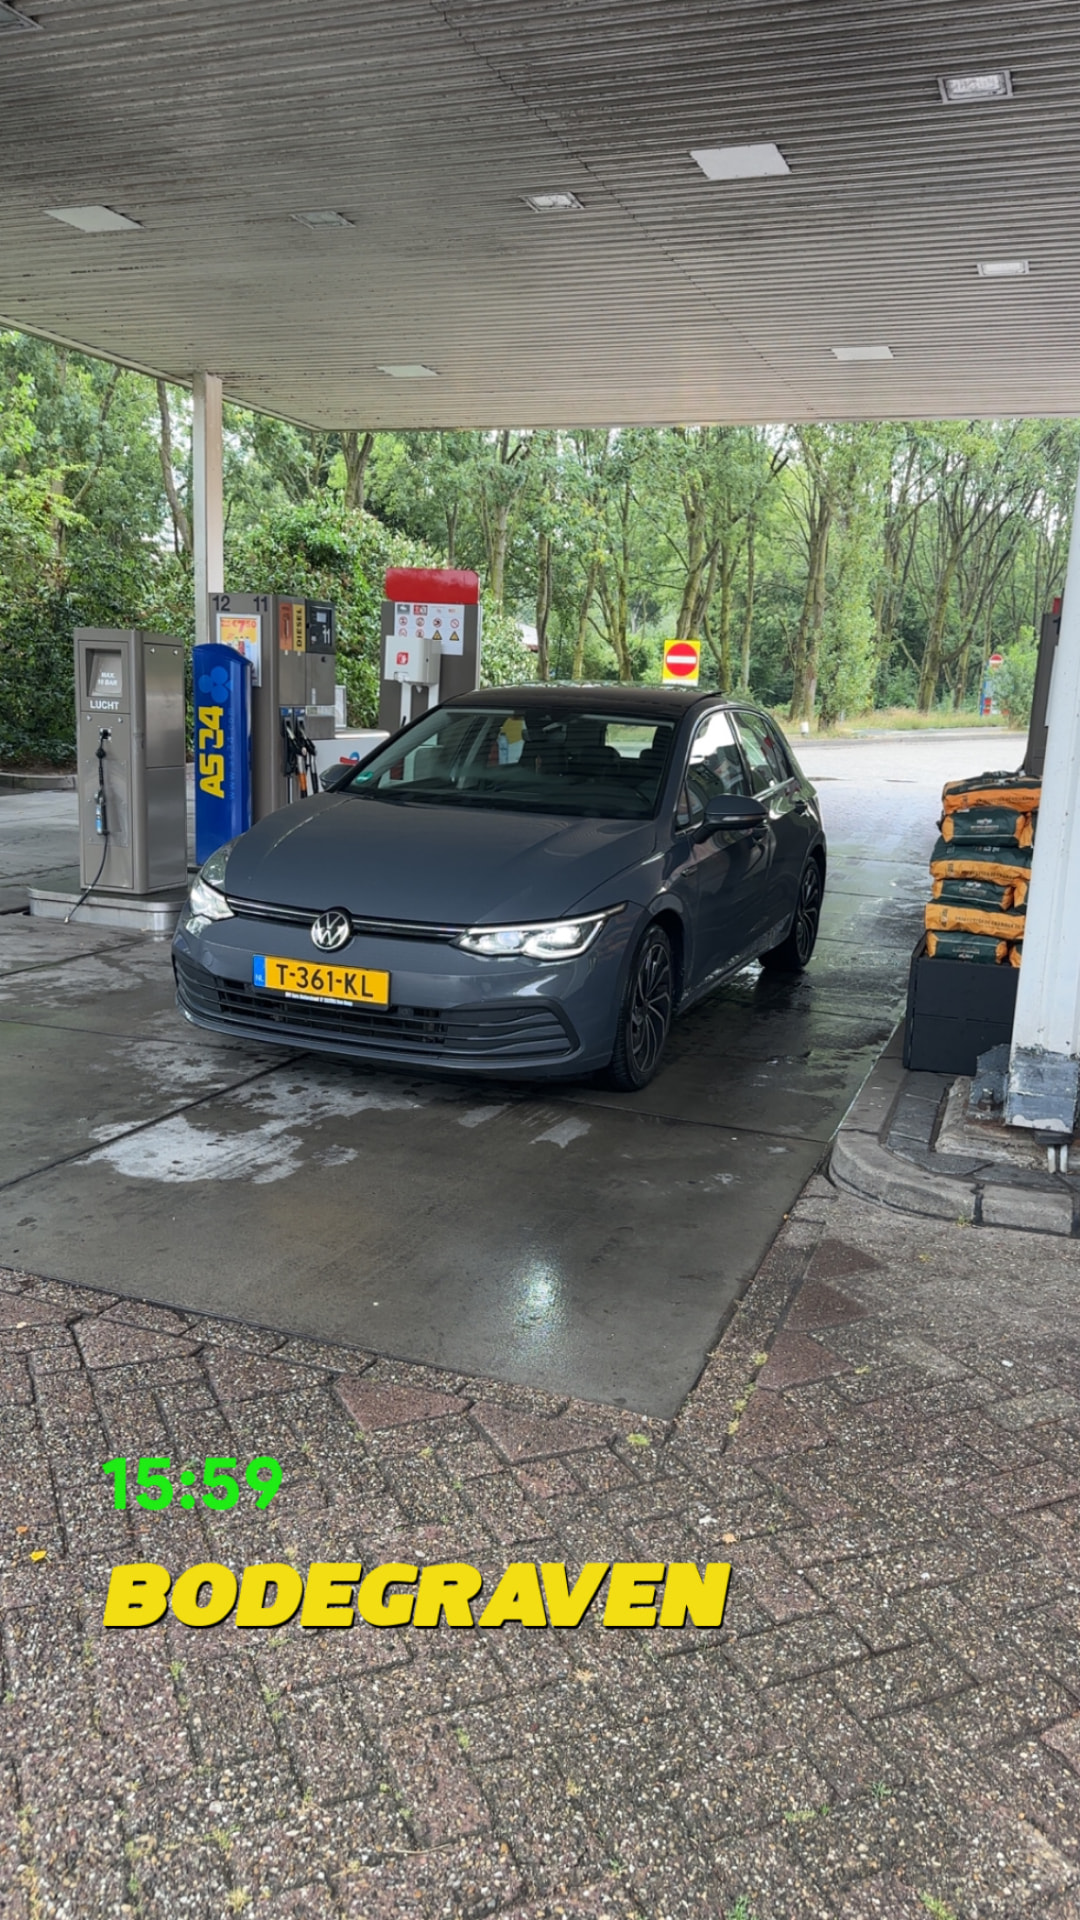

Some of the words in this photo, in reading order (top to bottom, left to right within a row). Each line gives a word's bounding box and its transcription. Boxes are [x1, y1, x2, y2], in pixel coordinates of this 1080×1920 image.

[212, 595, 231, 612] 12
[253, 596, 269, 612] 11
[295, 608, 303, 647] DIESEL
[90, 700, 119, 710] LUCHT
[276, 964, 374, 998] T-361-KL
